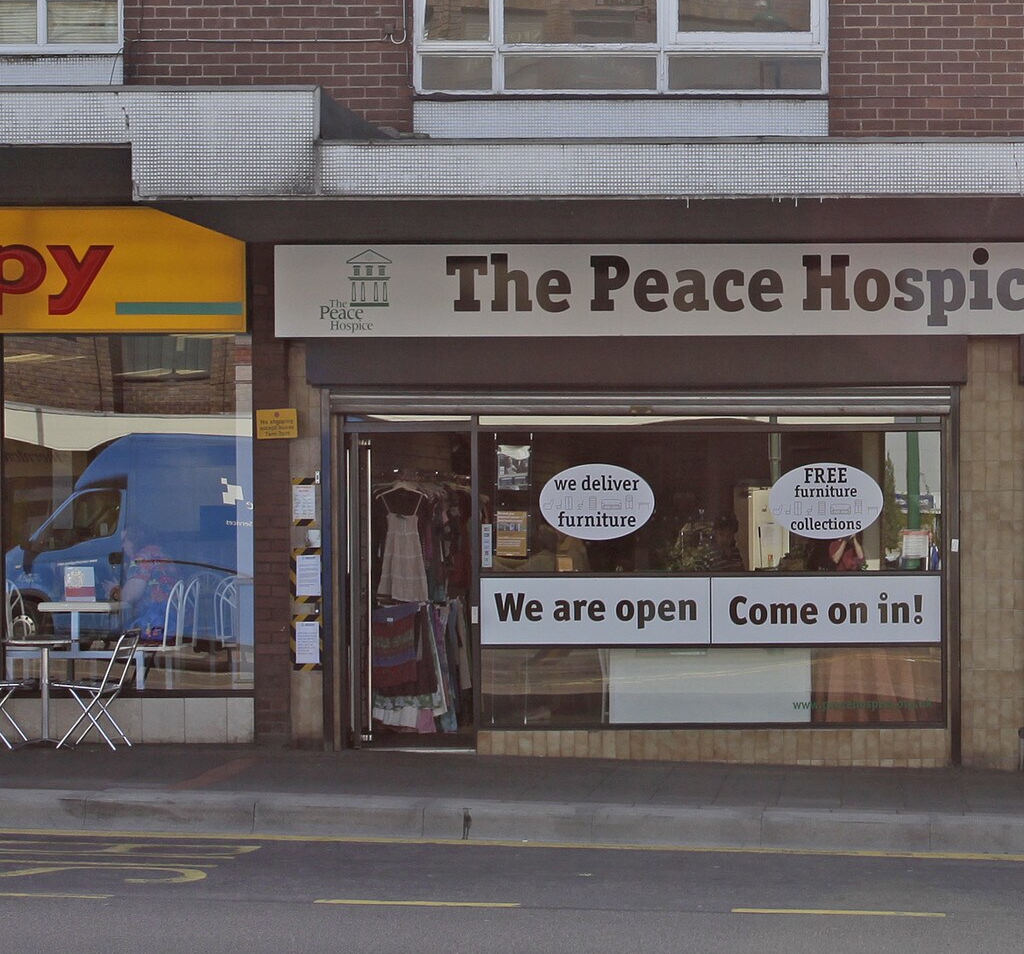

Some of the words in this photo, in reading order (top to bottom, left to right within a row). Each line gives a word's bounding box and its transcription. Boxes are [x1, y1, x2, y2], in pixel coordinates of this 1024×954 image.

[0, 244, 114, 315] py
[446, 253, 571, 312] The
[590, 255, 783, 312] Peace
[329, 299, 348, 308] The
[319, 305, 364, 320] Peace
[330, 320, 374, 333] Hospice
[553, 478, 576, 491] we
[581, 474, 640, 491] deliver
[803, 467, 848, 484] FREE
[794, 484, 858, 498] furniture
[557, 511, 637, 528] furniture
[789, 517, 863, 531] collections
[494, 593, 543, 621] We
[554, 600, 605, 621] are
[616, 600, 696, 628] open
[729, 596, 818, 625] Come
[828, 603, 867, 624] on
[878, 592, 924, 624] in!
